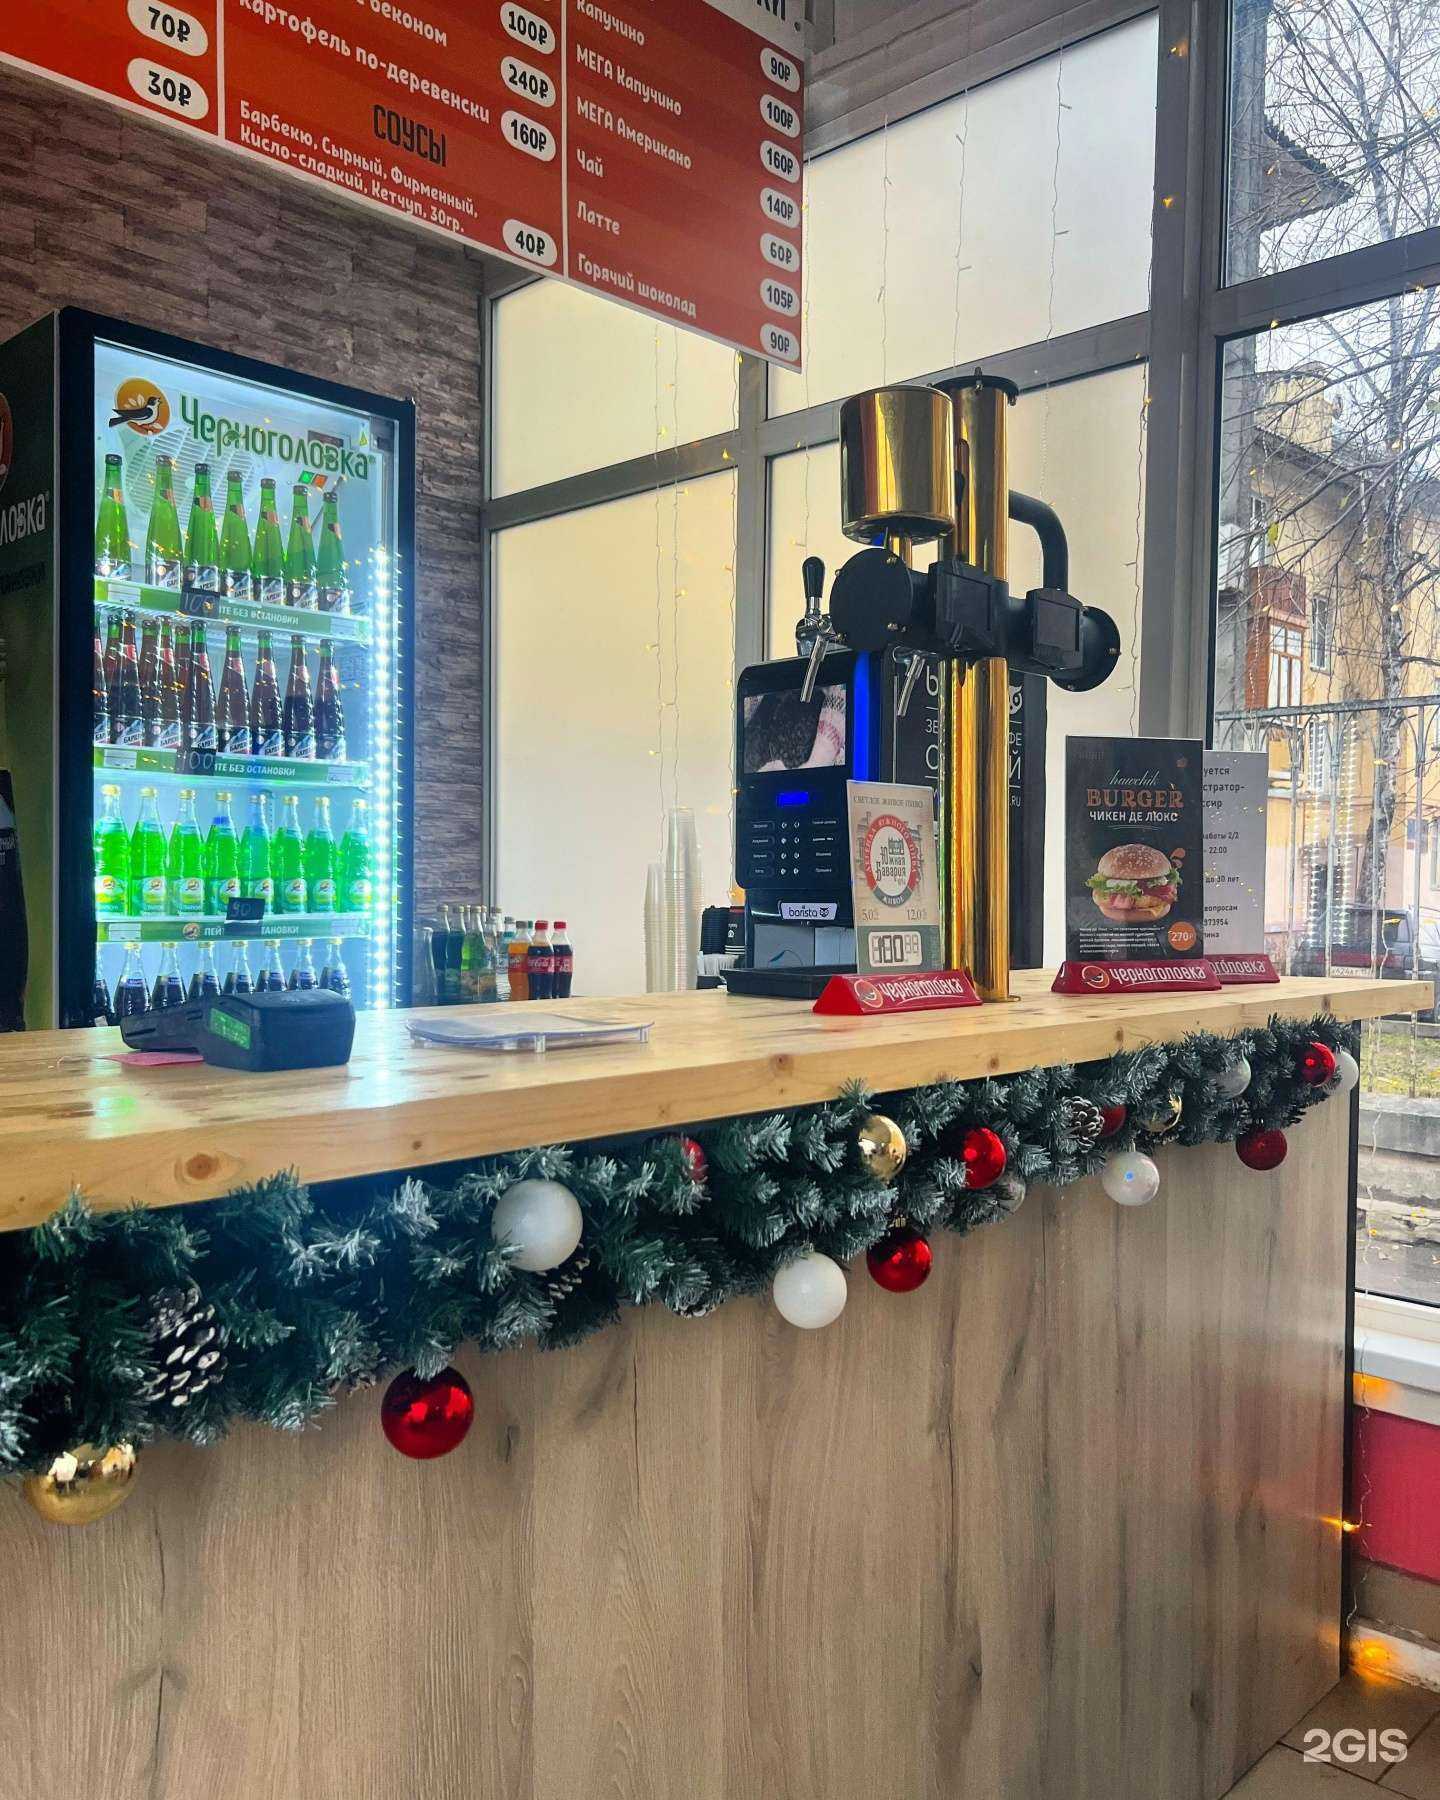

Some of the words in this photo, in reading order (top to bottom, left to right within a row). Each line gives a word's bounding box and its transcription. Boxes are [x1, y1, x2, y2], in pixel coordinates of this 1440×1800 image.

[148, 6, 191, 43] 70₽
[508, 10, 548, 45] 100₽
[508, 63, 549, 99] 240₽
[576, 44, 613, 80] МЕГА
[616, 65, 682, 117] Капучино
[770, 57, 791, 82] 90₽
[148, 70, 192, 107] 30₽
[356, 46, 490, 125] по-деревенски
[766, 101, 794, 130] 100₽
[240, 100, 318, 150] Барбекю,
[322, 135, 388, 180] Сырный,
[373, 104, 447, 167] СОУСЫ
[510, 119, 547, 152] 160₽
[576, 96, 614, 132] МЕГА
[617, 118, 692, 170] Американо
[576, 148, 604, 178] Чай
[766, 147, 794, 175] 160₽
[240, 124, 368, 195] Кисло-сладкий,
[430, 205, 465, 233] 30гр.
[577, 200, 621, 235] Латте
[766, 193, 794, 221] 140₽
[515, 229, 546, 257] 40₽
[769, 241, 792, 265] 60₽
[577, 253, 635, 292] Горячий
[638, 280, 697, 319] шоколад
[766, 284, 794, 310] 105₽
[769, 331, 791, 353] 90₽
[233, 607, 248, 617] БЕЗ
[250, 610, 299, 625] ОСТАНОВКИ
[229, 764, 245, 773] БЕЗ
[246, 765, 296, 776] ОСТАНОВКИ
[1203, 766, 1231, 778] уется
[1086, 787, 1185, 809] BURGER
[1202, 784, 1245, 794] стратор-
[1089, 811, 1126, 822] ЧИКЕН
[1129, 811, 1143, 823] ДЕ
[1145, 811, 1178, 822] ЛЮКС
[1203, 832, 1227, 840] аботы
[788, 906, 817, 918] barista
[204, 925, 225, 936] ПЕЙ
[261, 925, 300, 935] ТАНОВКИ
